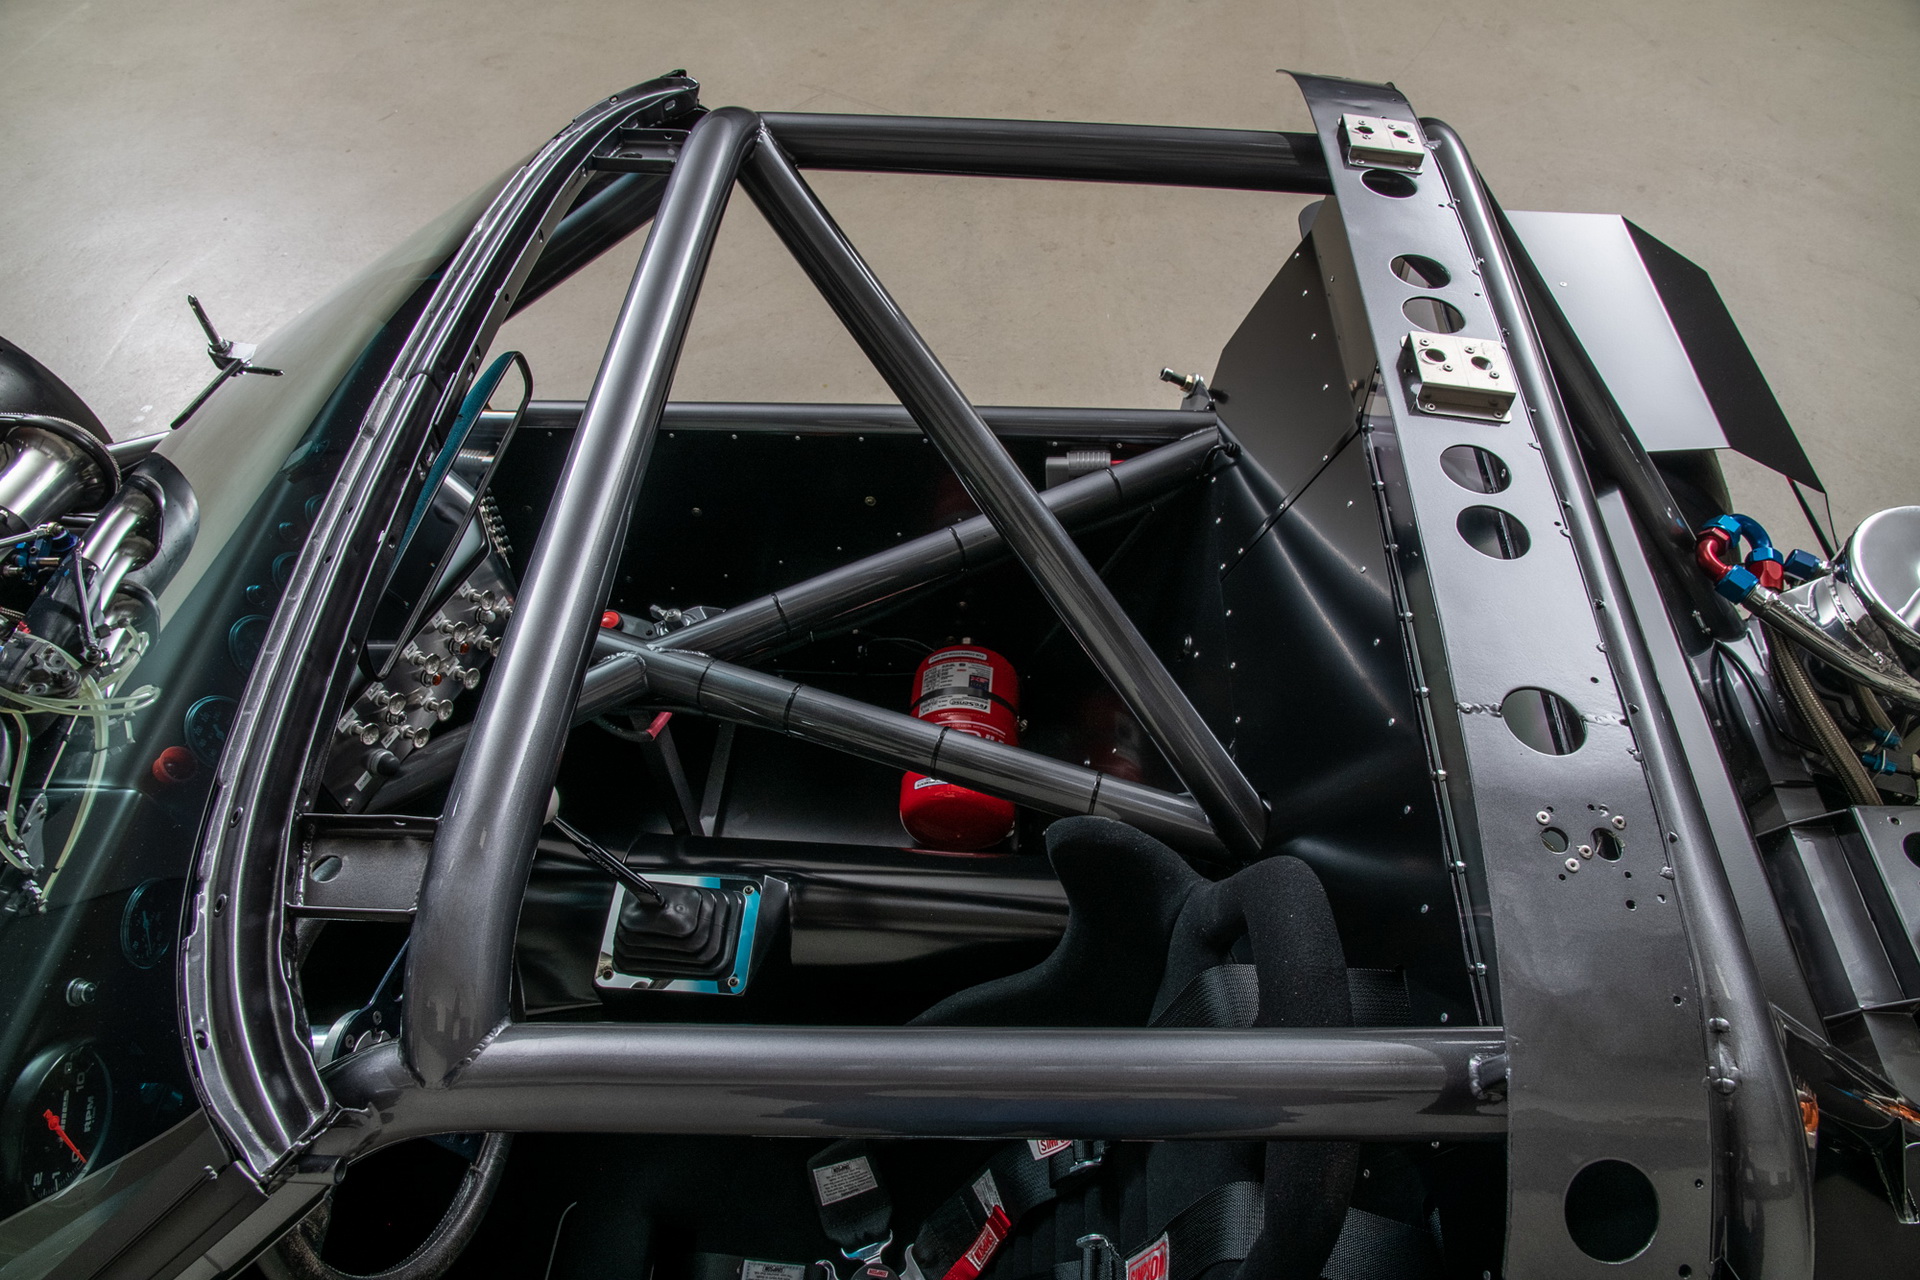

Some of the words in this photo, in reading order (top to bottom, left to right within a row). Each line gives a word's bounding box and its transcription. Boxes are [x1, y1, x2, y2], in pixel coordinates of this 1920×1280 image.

[76, 1072, 85, 1092] 10
[84, 1096, 94, 1132] RPM
[33, 1172, 43, 1186] 2
[868, 1268, 888, 1277] SIMPSON
